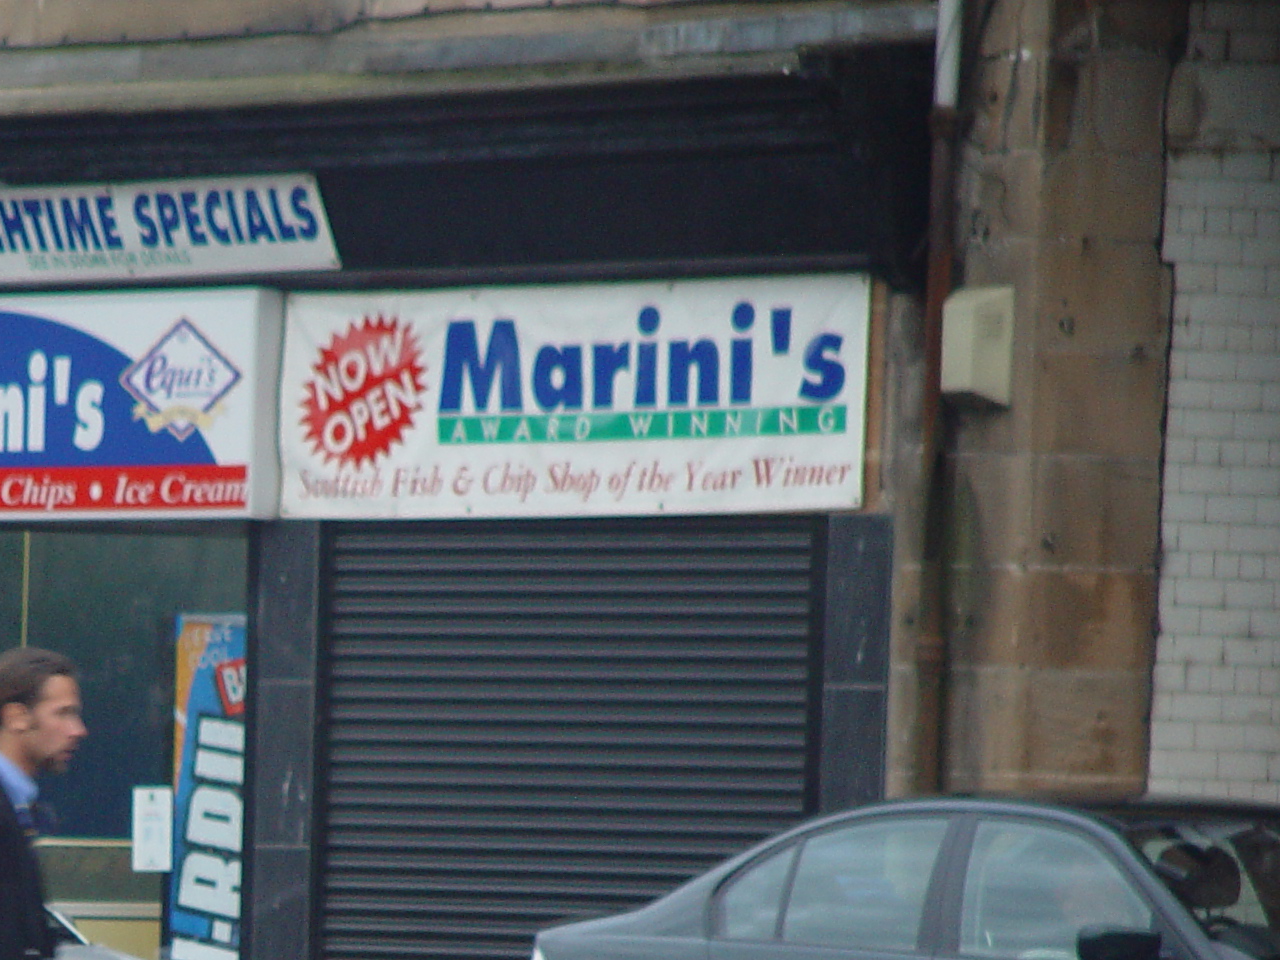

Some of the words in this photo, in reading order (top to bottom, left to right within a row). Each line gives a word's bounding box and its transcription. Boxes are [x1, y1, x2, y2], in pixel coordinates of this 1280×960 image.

[133, 185, 318, 248] SPECIALS
[313, 325, 404, 412] NOW
[437, 302, 846, 413] Marini's
[322, 369, 418, 454] OPEN
[450, 415, 592, 443] AWARD
[627, 409, 837, 438] WINNING
[1, 474, 77, 511] Chips
[113, 474, 155, 505] Ice
[160, 473, 247, 504] Cream
[391, 464, 444, 498] Fish
[482, 461, 538, 503] Chip
[545, 461, 601, 502] Shop
[608, 460, 636, 502] of
[637, 460, 673, 492] the
[685, 460, 743, 492] Year
[751, 457, 852, 488] Winner
